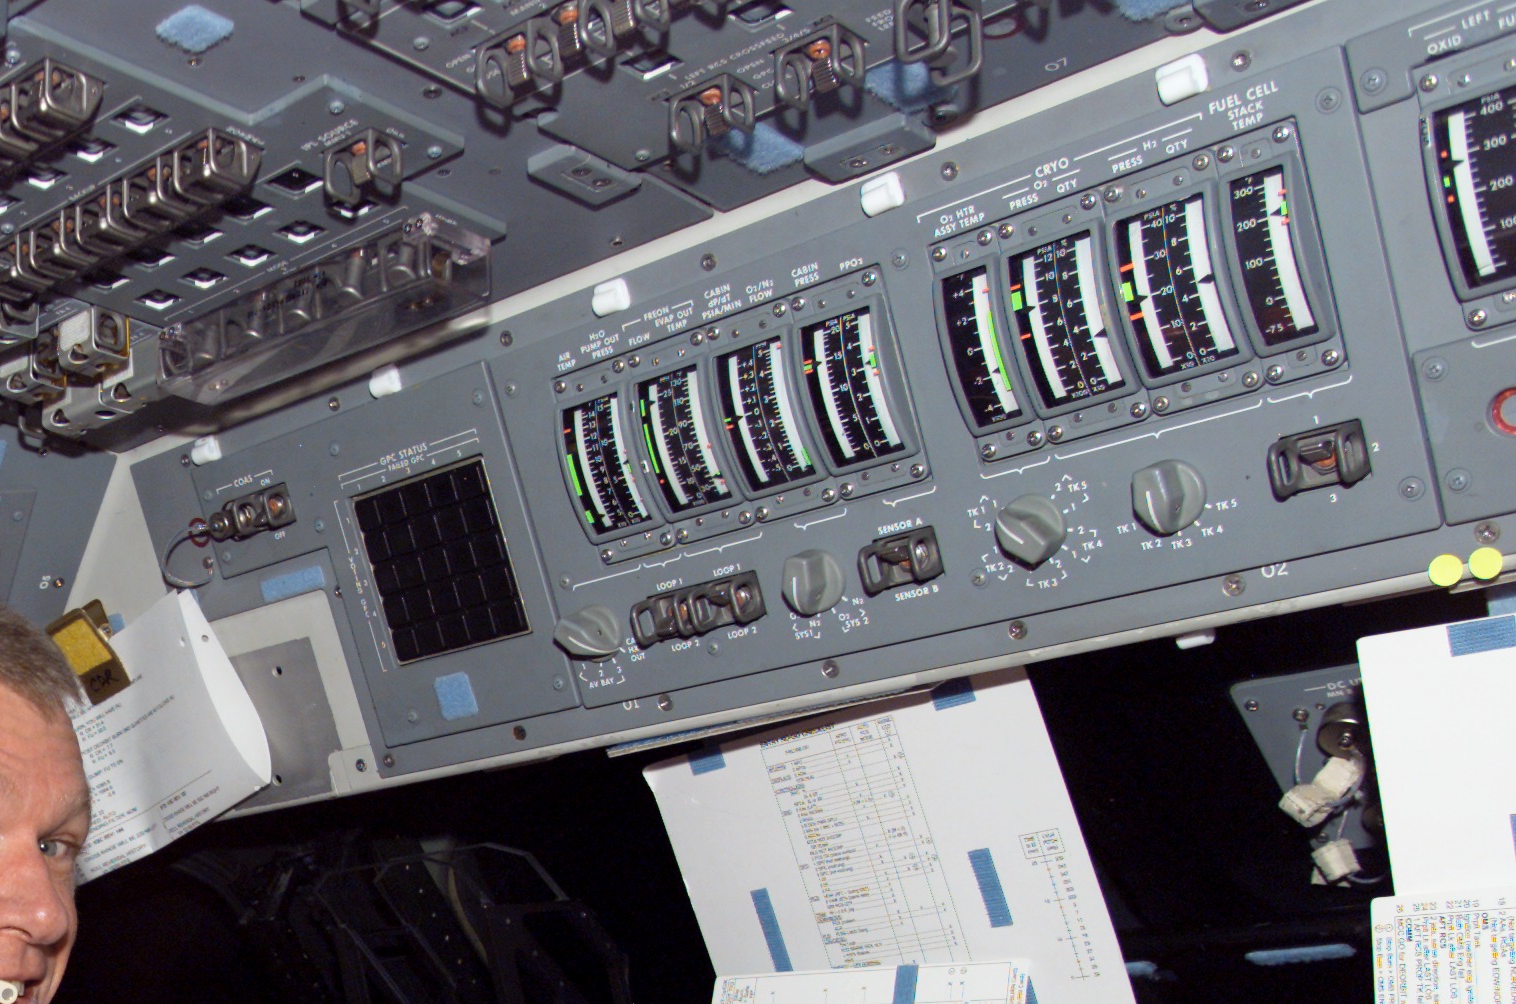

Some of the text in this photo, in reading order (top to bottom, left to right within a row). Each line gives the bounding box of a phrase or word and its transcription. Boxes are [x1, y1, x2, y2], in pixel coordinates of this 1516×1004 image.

[1461, 10, 1490, 29] LEFT
[1427, 35, 1462, 54] OXID
[1208, 81, 1278, 114] FUEL CELL
[1227, 101, 1264, 120] STACK
[1480, 101, 1503, 116] 400
[1232, 113, 1264, 130] TEMP
[1483, 136, 1507, 150] 300
[1112, 139, 1188, 173] PRESS QTY
[1035, 158, 1069, 178] CRYO
[1490, 176, 1513, 191] 200
[1009, 179, 1078, 210] PRESS QTY
[1233, 186, 1254, 200] 300
[955, 205, 975, 219] HTR
[934, 213, 984, 238] ASSY TEMP
[1236, 219, 1256, 232] 200
[1043, 254, 1053, 262] 12
[1153, 250, 1166, 259] 30
[1245, 257, 1263, 270] 100
[791, 262, 818, 278] CABIN
[1175, 267, 1182, 276] 6
[794, 272, 819, 287] PRESS
[704, 284, 730, 299] CABIN
[749, 289, 773, 303] FLOW
[1160, 286, 1173, 296] 20
[1181, 294, 1189, 303] 4
[644, 307, 669, 321] FREON
[702, 300, 742, 320] PSIA/MIN
[655, 308, 694, 328] EVAP OUT
[667, 320, 688, 332] TEMP
[1072, 326, 1079, 334] 4
[1190, 321, 1198, 330] 2
[580, 334, 619, 354] PUMP OUT
[629, 333, 651, 346] FLOW
[558, 352, 571, 362] AIR
[592, 347, 614, 359] PRESS
[1080, 352, 1088, 361] 2
[557, 360, 576, 372] TEMP
[856, 393, 863, 401] 2
[1313, 415, 1319, 424] 1
[1371, 442, 1380, 452] 2
[380, 442, 428, 465] GPC STATUS
[411, 455, 424, 464] GPC
[233, 474, 253, 488] COAS
[1068, 484, 1080, 493] TK
[1330, 493, 1337, 503] 3
[1216, 499, 1237, 511] TK 5
[967, 508, 980, 517] TK
[877, 517, 923, 535] SENSOR A
[1201, 525, 1224, 537] TK 4
[1082, 540, 1102, 551] TK 4
[713, 566, 734, 577] LOOP
[656, 580, 677, 591] LOOP
[1037, 578, 1058, 589] TK 3
[895, 585, 939, 602] SENSOR B
[845, 619, 860, 629] SYS
[727, 626, 758, 640] LOOP 2
[672, 641, 692, 652] LOOP
[631, 653, 646, 662] OUT
[589, 678, 614, 689] AV BAY
[1326, 681, 1346, 691] DC
